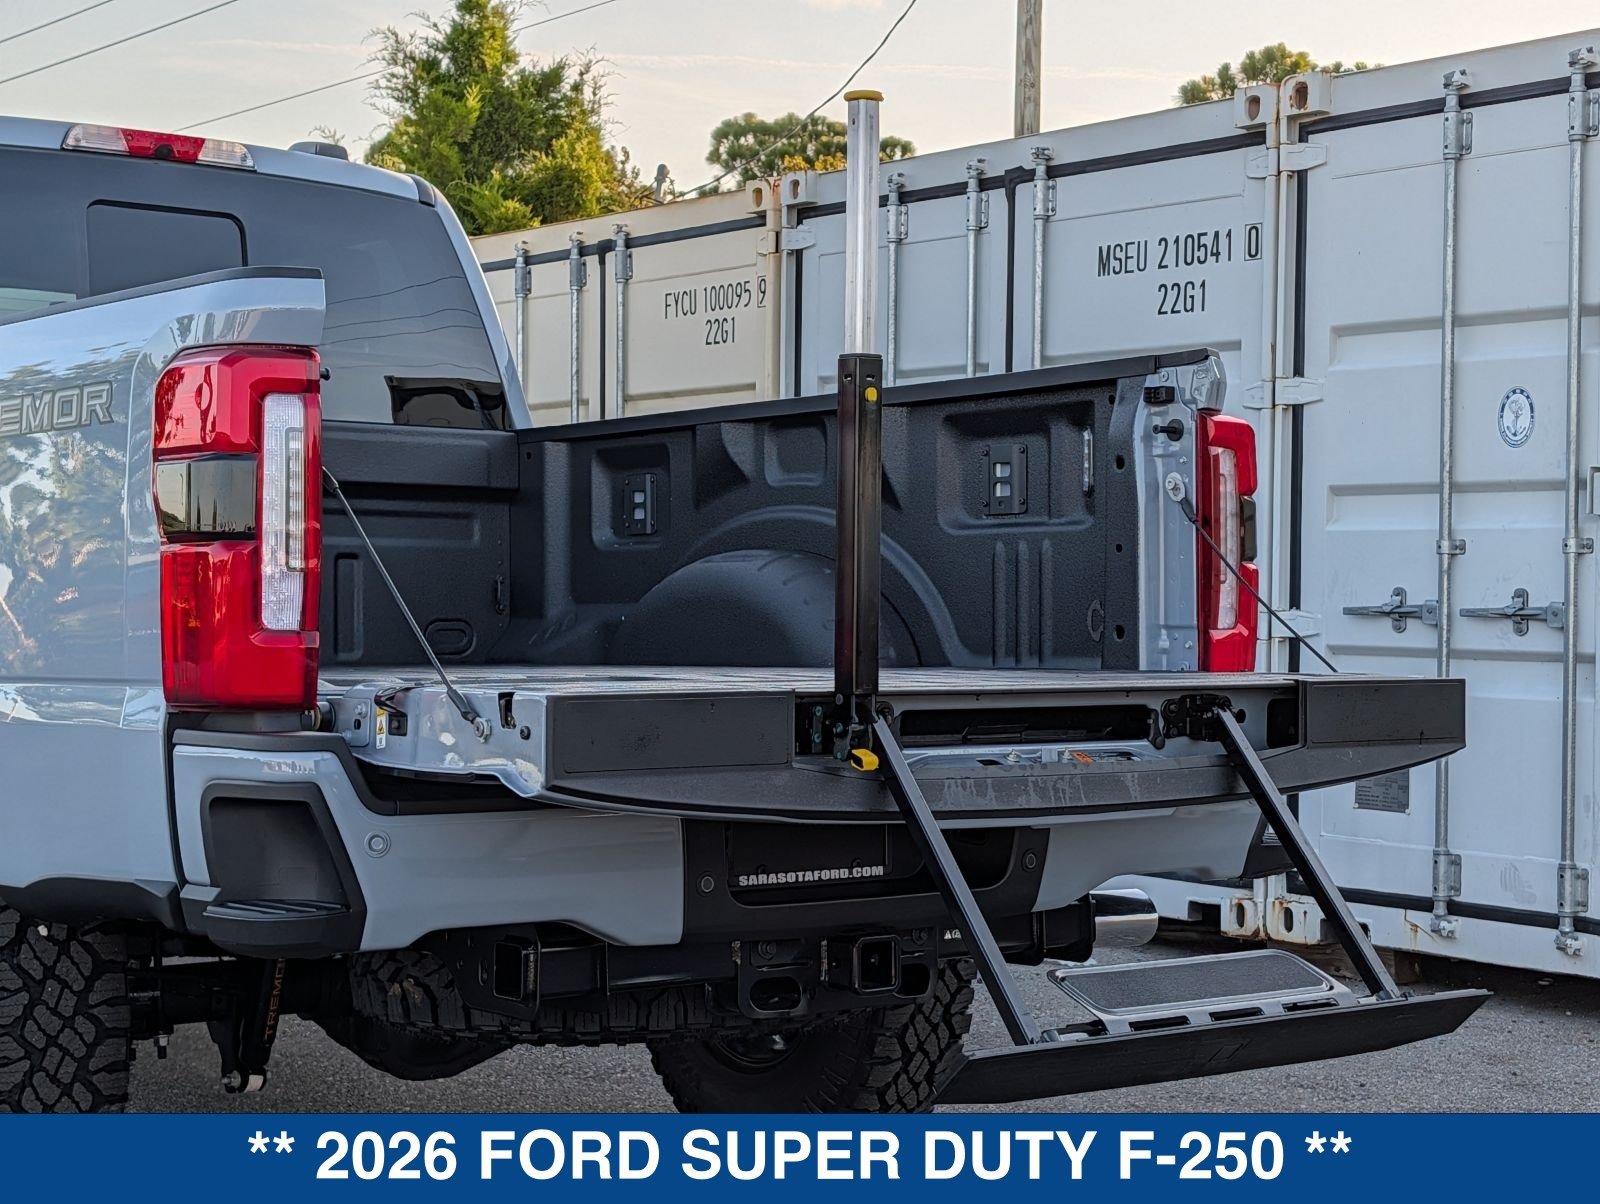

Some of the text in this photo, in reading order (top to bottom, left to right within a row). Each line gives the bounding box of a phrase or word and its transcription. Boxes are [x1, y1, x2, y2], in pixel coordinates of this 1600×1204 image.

[1097, 225, 1260, 277] MSEU 210541 0
[664, 278, 767, 319] FYCU 100095 9
[1157, 279, 1206, 315] 22G1
[705, 316, 735, 345] 22G1
[0, 381, 114, 437] EMOR
[739, 866, 884, 886] SARASOTAFORD.COM
